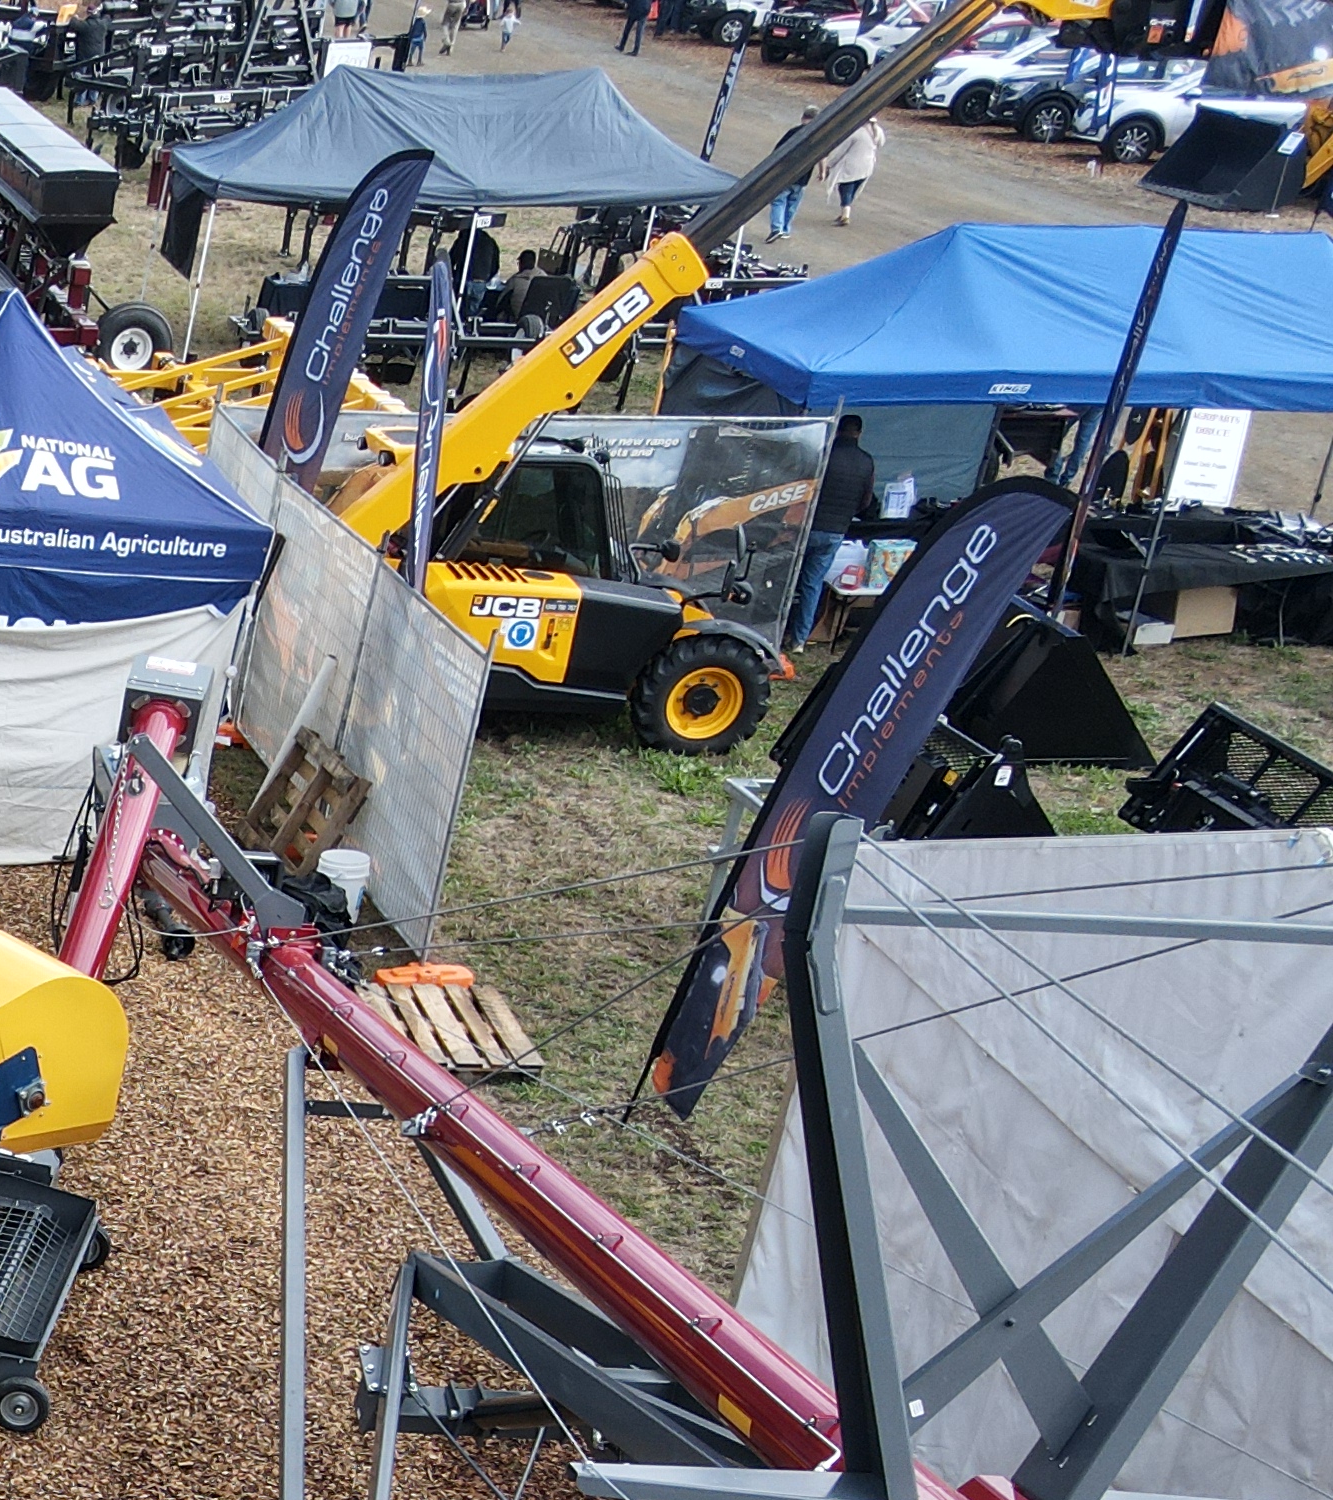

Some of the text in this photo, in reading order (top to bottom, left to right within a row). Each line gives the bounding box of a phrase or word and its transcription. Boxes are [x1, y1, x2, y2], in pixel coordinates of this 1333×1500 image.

[306, 188, 388, 382] Challenge
[568, 286, 650, 365] JCB
[21, 434, 116, 461] NATIONAL
[20, 451, 121, 500] AG
[749, 484, 808, 512] CASE
[101, 531, 227, 557] Agriculture
[471, 596, 542, 618] JCB
[818, 523, 997, 796] Challenge
